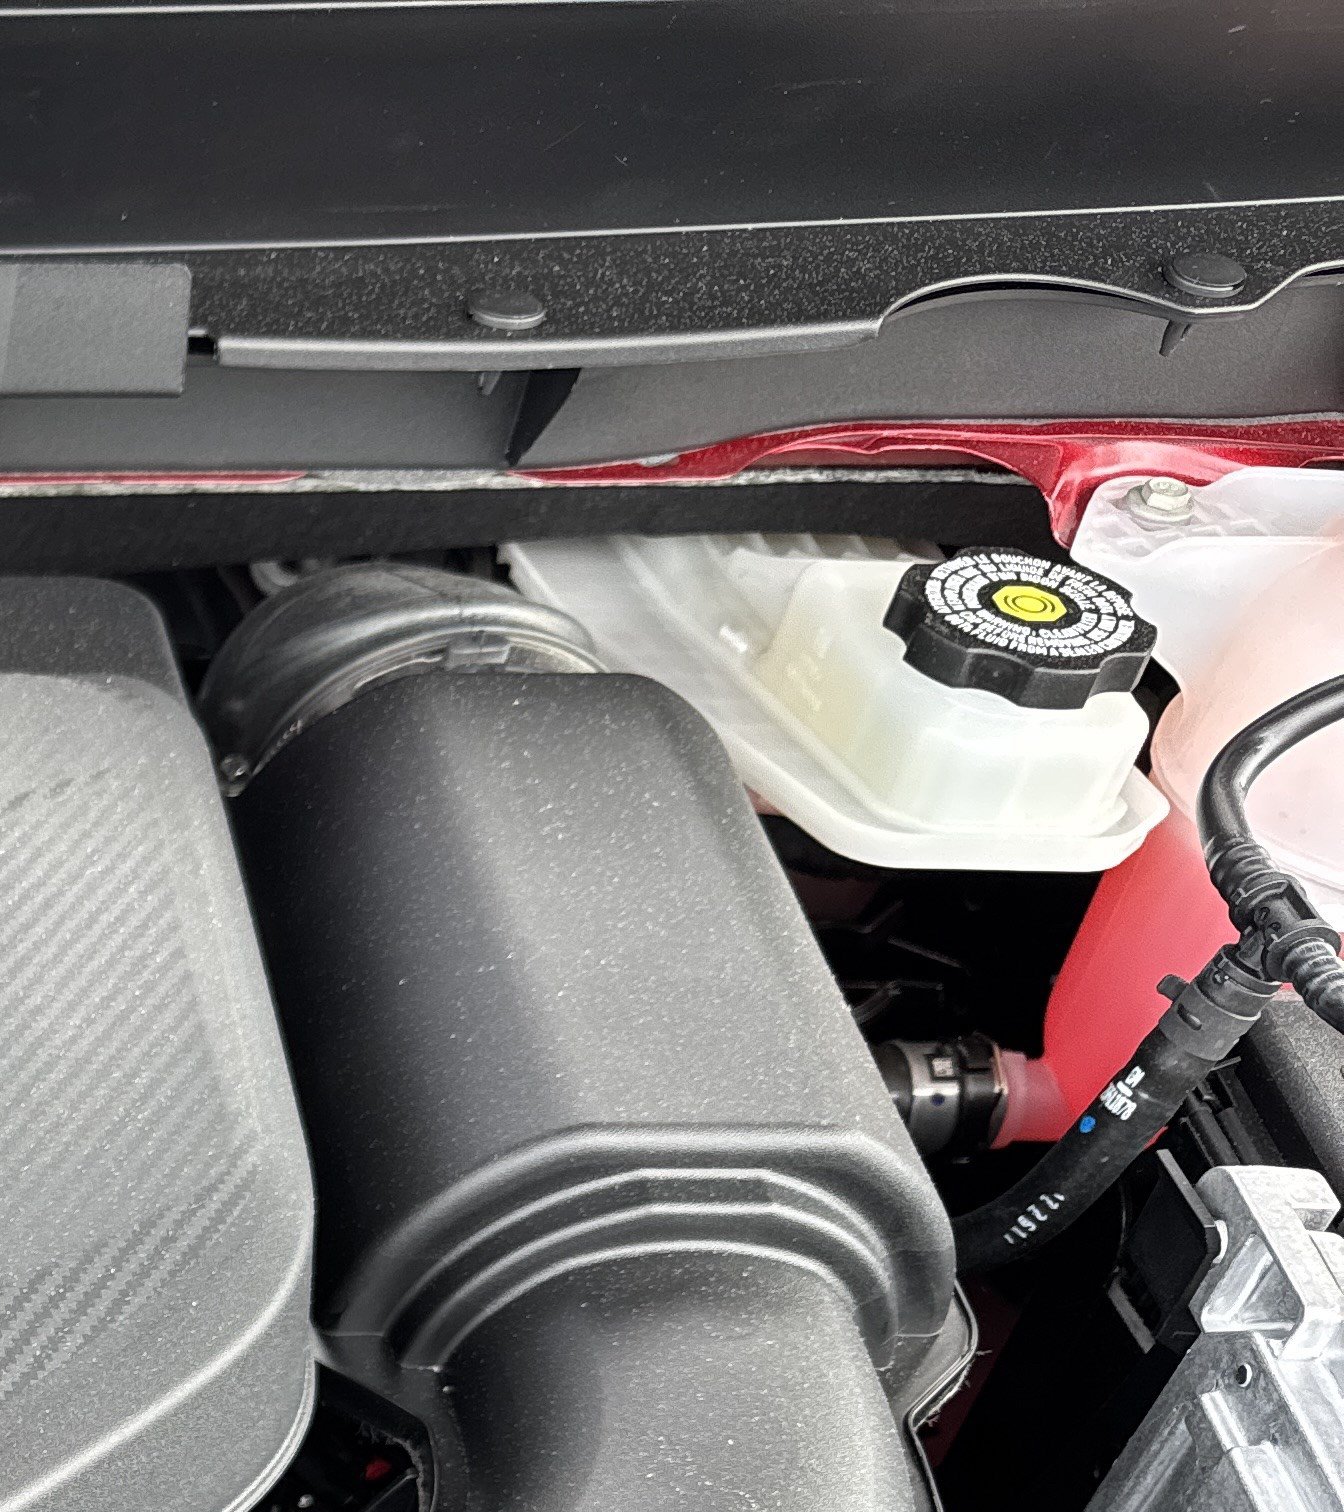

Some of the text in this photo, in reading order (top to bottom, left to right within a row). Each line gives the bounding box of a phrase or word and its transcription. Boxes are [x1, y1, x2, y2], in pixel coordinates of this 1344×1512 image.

[991, 554, 1051, 568] BOUCHON
[1053, 564, 1094, 581] AVANT
[970, 629, 1008, 647] FLUID
[1008, 642, 1048, 655] FROM
